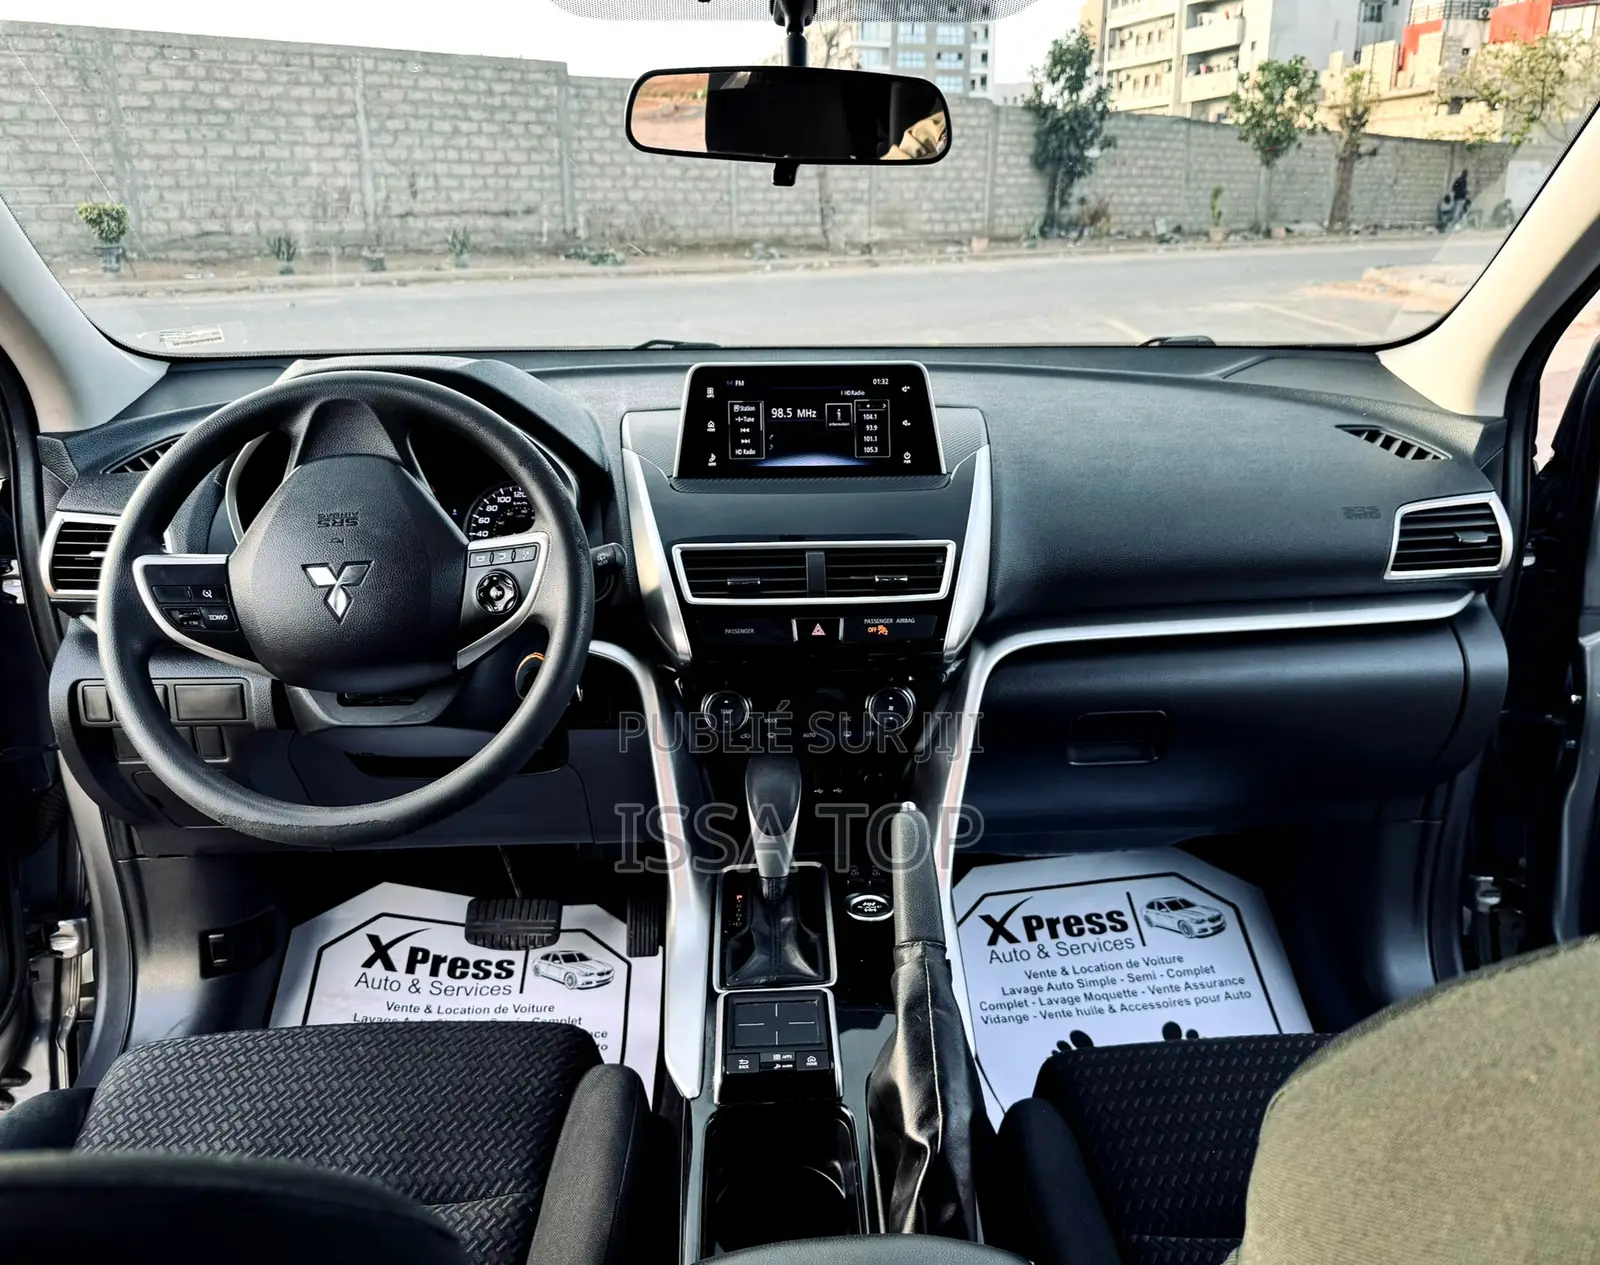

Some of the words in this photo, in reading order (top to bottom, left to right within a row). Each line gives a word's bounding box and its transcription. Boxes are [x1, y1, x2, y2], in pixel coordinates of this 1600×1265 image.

[771, 407, 793, 418] 98.5
[796, 408, 817, 418] MHz
[989, 947, 1031, 964] Auto
[1037, 943, 1050, 959] &
[1055, 937, 1135, 957] Services
[1000, 983, 1044, 996] Lavage
[1046, 981, 1074, 992] Auto
[1076, 976, 1117, 989] Simple
[1126, 970, 1157, 983] Semi
[1166, 964, 1216, 979] Complet
[1024, 968, 1057, 980] Vente
[1060, 966, 1069, 976] &
[1071, 961, 1123, 975] Location
[1125, 958, 1140, 969] de
[1141, 954, 1184, 967] Voiture
[354, 971, 401, 992] Auto
[408, 977, 421, 994] &
[429, 980, 513, 997] Services
[979, 998, 1029, 1011] Complet
[1038, 993, 1081, 1006] Lavage
[1083, 987, 1138, 1003] Moquette
[1147, 983, 1181, 996] Vente
[1184, 976, 1245, 991] Assurance
[386, 1001, 421, 1013] Vente
[424, 1004, 433, 1014] &
[437, 1004, 490, 1015] Location
[494, 1004, 509, 1014] de
[512, 1004, 555, 1014] Voiture
[980, 1012, 1030, 1025] Vidange
[1039, 1007, 1073, 1020] Vente
[1075, 1005, 1105, 1017] huile
[1108, 1003, 1117, 1014] &
[1120, 997, 1191, 1013] Accessoires
[1194, 994, 1221, 1007] pour
[1224, 990, 1252, 1002] Auto
